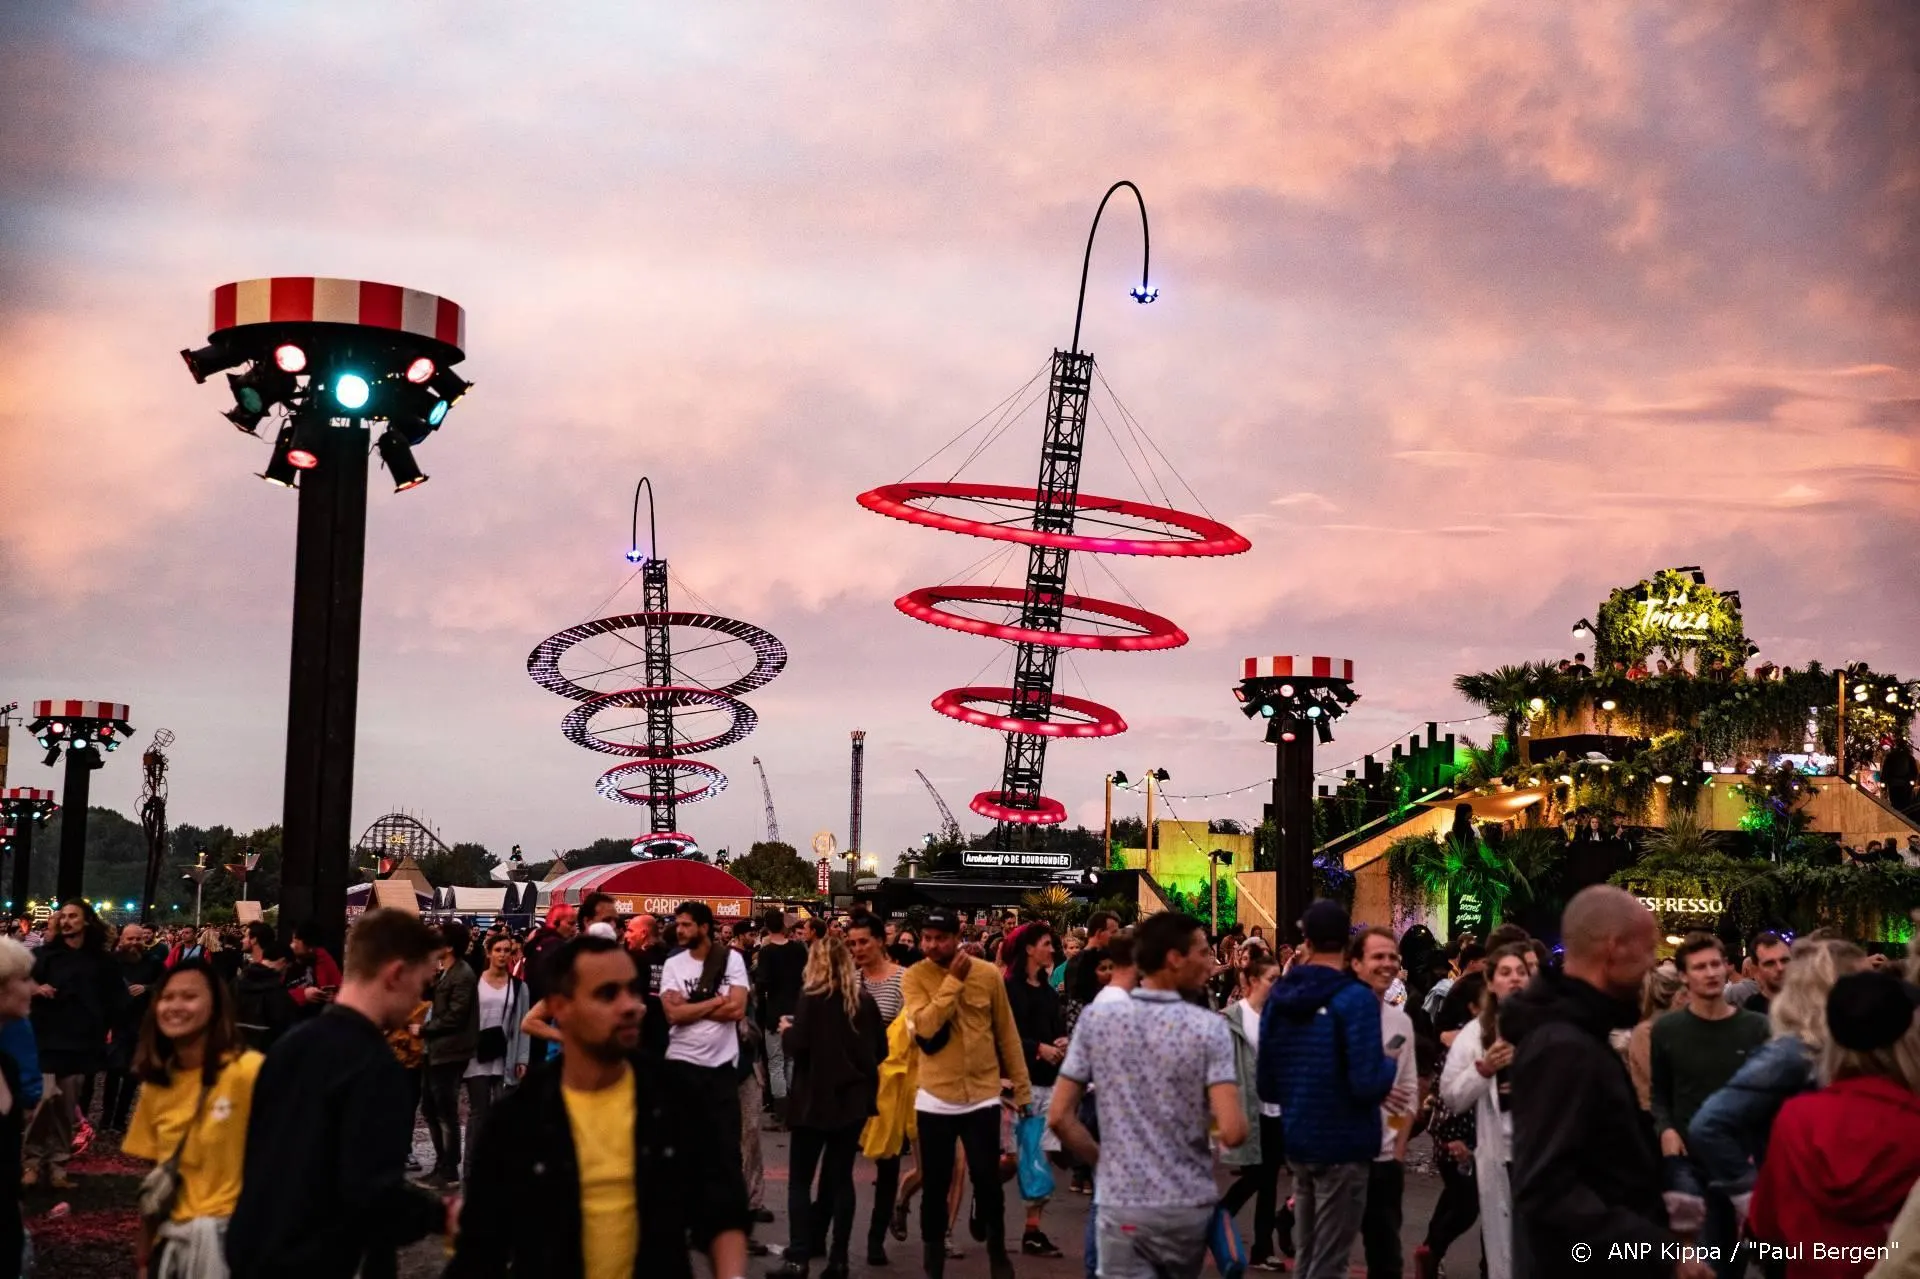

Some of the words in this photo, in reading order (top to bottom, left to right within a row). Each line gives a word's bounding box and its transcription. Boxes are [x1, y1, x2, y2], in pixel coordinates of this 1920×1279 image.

[1010, 855, 1020, 864] DE
[1460, 903, 1481, 912] secret
[1637, 897, 1723, 913] ESPRESSO
[1455, 912, 1481, 925] getaway
